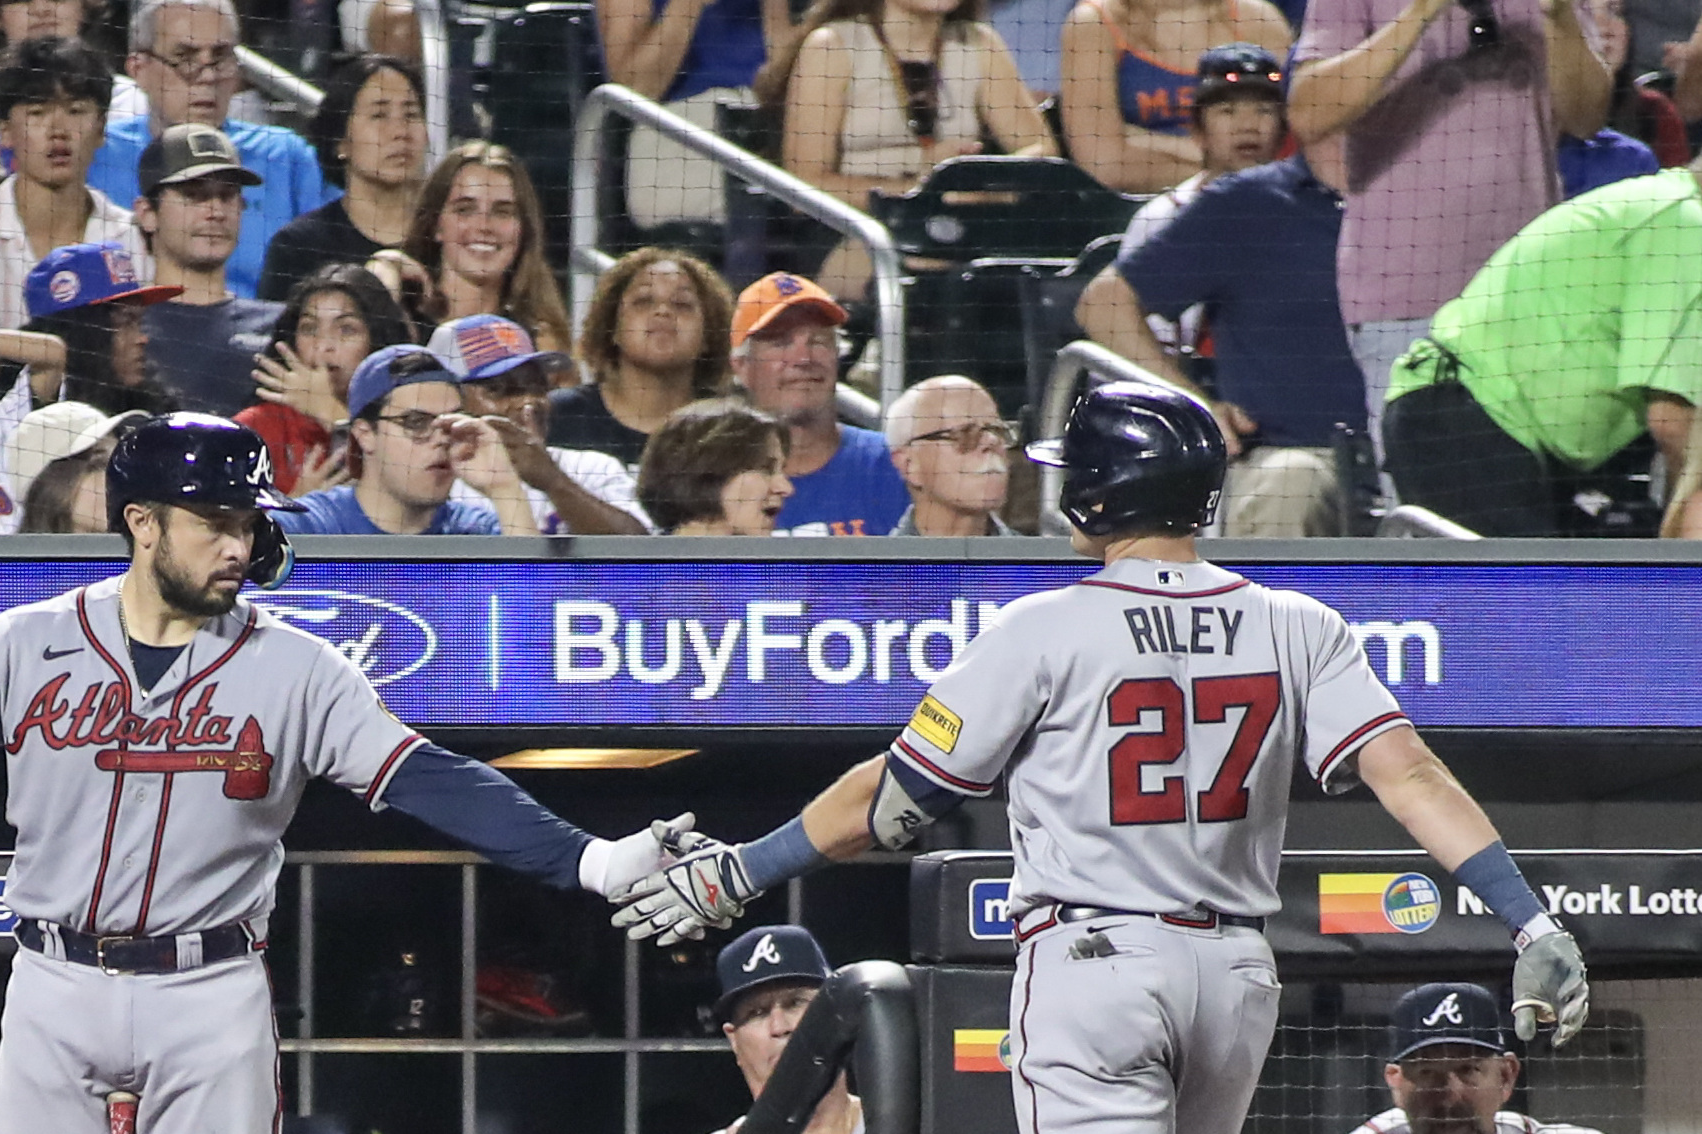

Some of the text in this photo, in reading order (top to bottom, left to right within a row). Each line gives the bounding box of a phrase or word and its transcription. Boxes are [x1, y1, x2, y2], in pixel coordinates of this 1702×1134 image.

[246, 445, 273, 484] A
[554, 598, 996, 700] BuyFord
[1124, 606, 1244, 655] RILEY
[6, 671, 234, 755] Atlanta
[919, 702, 959, 737] QUIKRETE
[1108, 671, 1282, 827] 27
[1541, 884, 1702, 915] York Lott
[742, 933, 781, 972] A
[1422, 992, 1463, 1026] A
